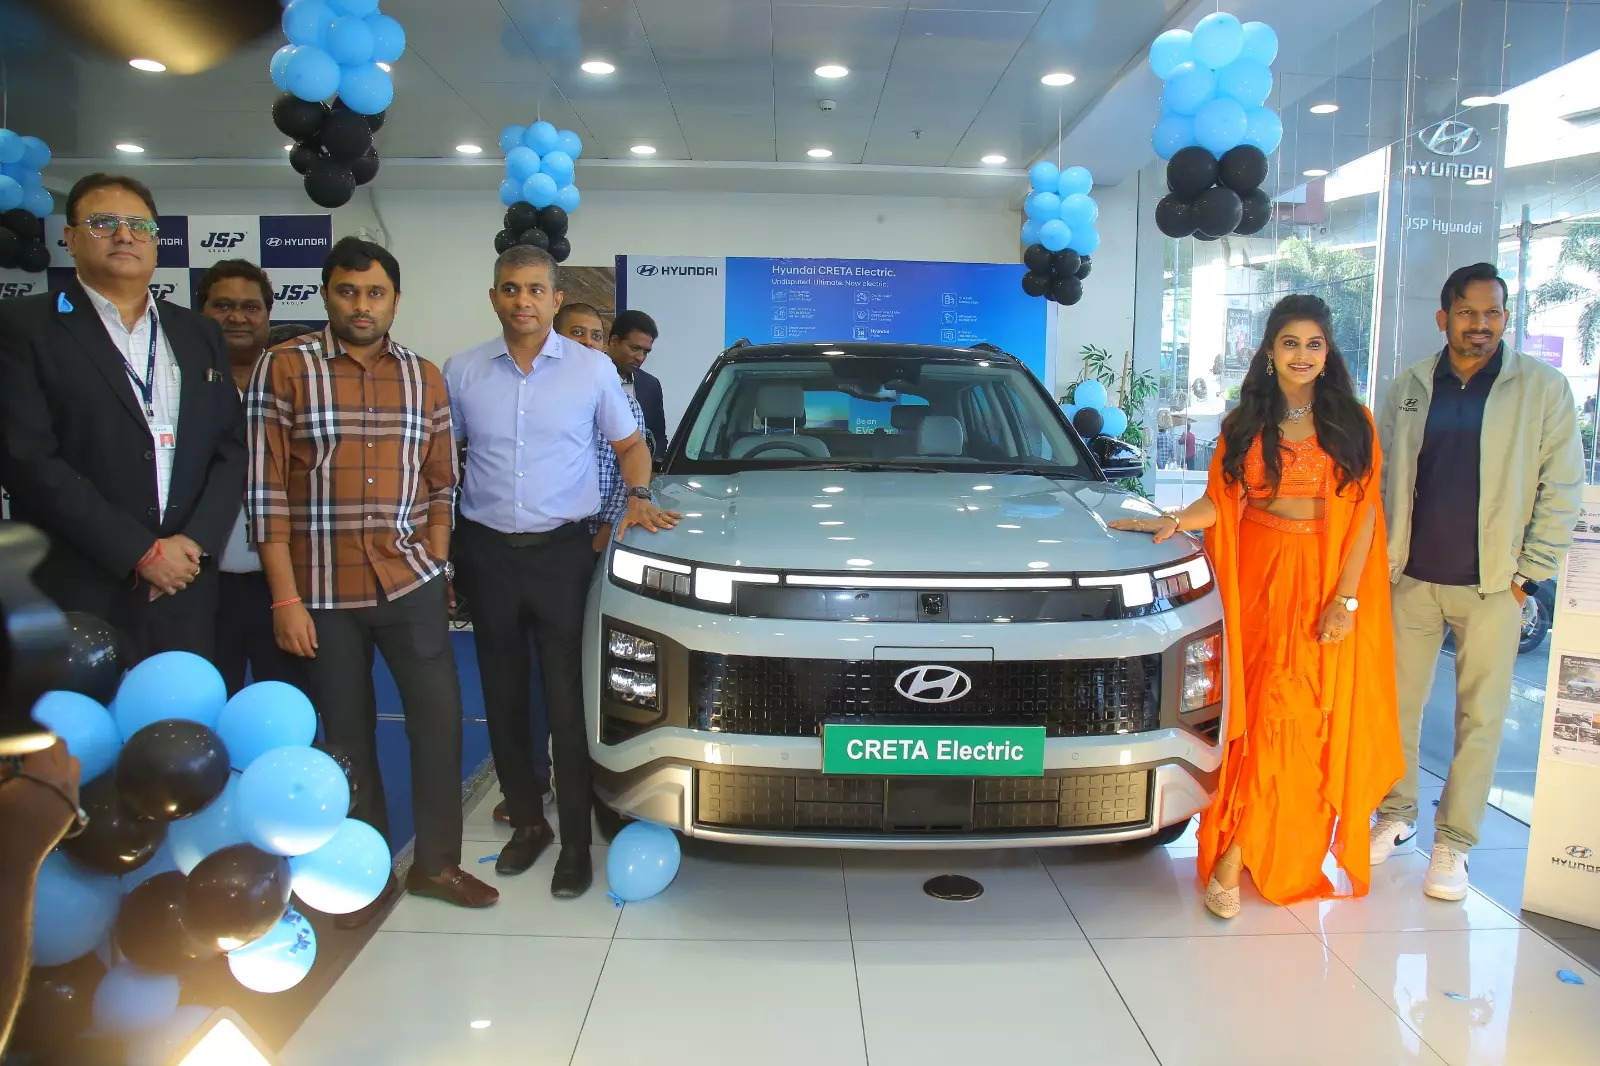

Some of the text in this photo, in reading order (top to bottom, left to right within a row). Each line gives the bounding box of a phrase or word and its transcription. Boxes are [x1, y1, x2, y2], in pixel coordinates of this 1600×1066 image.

[1404, 161, 1492, 180] HYUNDAI
[1406, 218, 1482, 235] JSP Hyundai
[156, 238, 183, 246] NDAI
[200, 232, 245, 248] JSP
[284, 238, 327, 246] HYUNDAI
[661, 266, 718, 276] HYUNDAI
[772, 265, 896, 277] Hyundai CRETA Electric.
[148, 284, 176, 300] SP
[273, 284, 318, 300] JSP
[855, 427, 893, 435] EVoer
[846, 739, 1024, 760] CRETA Electric
[1551, 857, 1600, 873] HYUNDA
